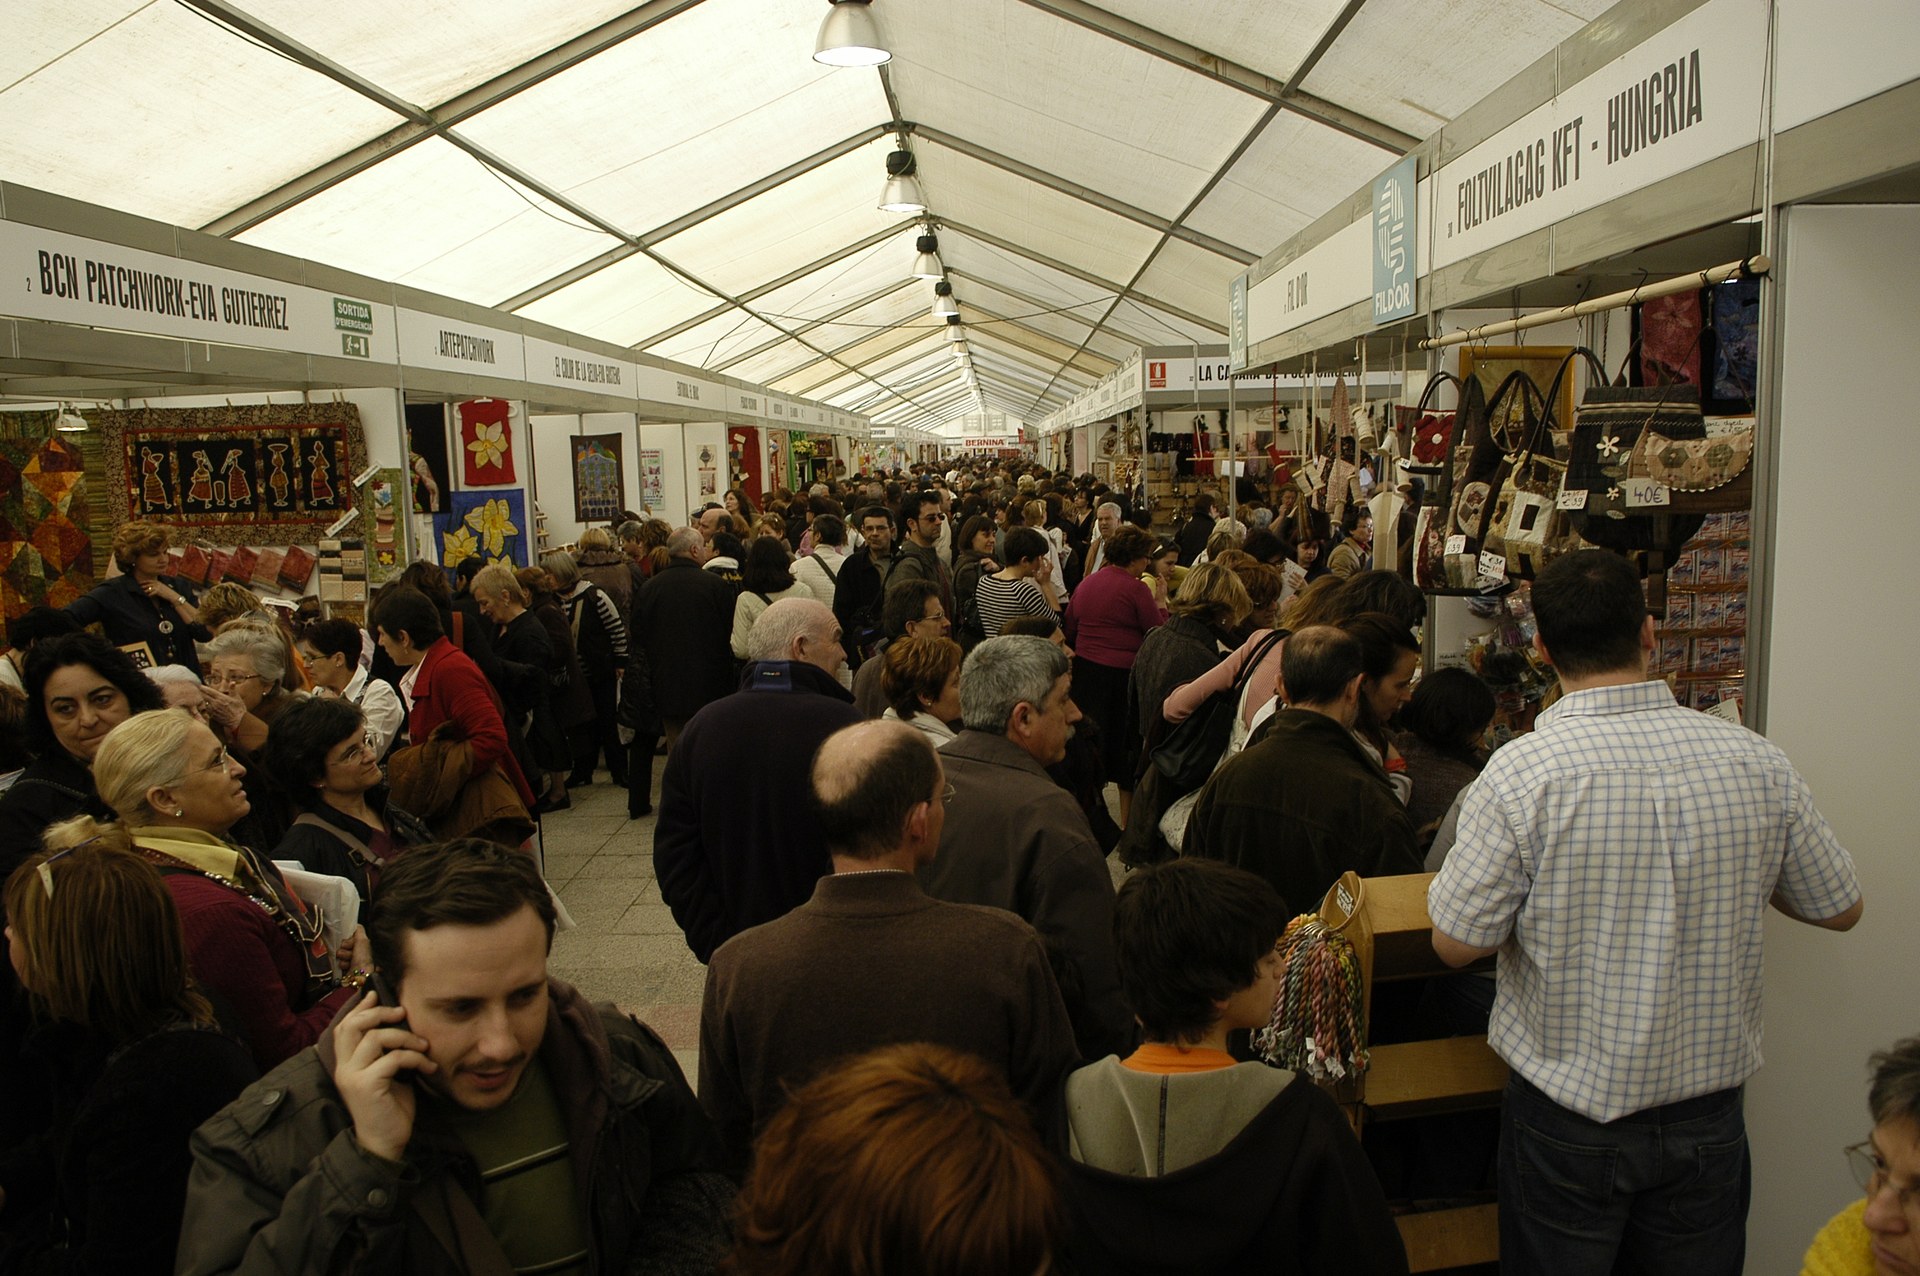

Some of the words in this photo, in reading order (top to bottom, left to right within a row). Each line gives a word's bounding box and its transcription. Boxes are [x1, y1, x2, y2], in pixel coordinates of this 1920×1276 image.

[1457, 138, 1546, 235] FOLTVILAGAG
[1551, 115, 1583, 192] KFT
[1607, 48, 1703, 166] HUNGRIA
[38, 249, 80, 300] BCN
[85, 260, 218, 322] PATCHWORK-EVA
[221, 286, 290, 331] GUTIERREZ
[1374, 282, 1410, 318] FILDOR
[337, 302, 370, 319] SORTIDA
[439, 330, 496, 364] ARTEPATCHWORK
[1199, 365, 1212, 381] LA
[965, 438, 1005, 447] BERNINA
[1634, 486, 1663, 504] 40€
